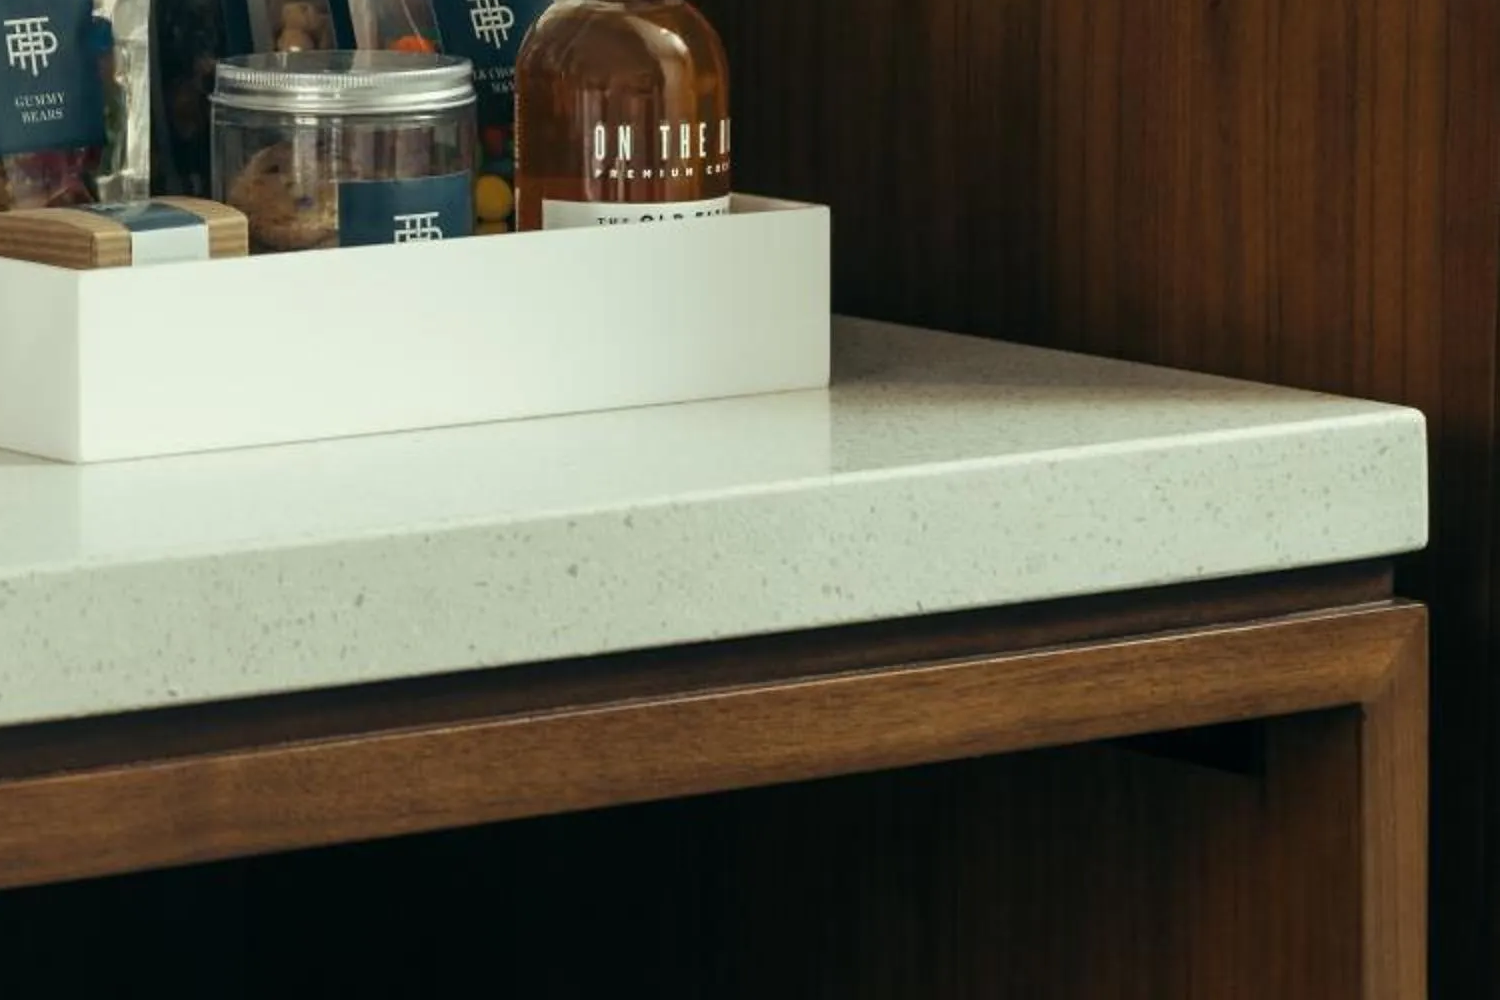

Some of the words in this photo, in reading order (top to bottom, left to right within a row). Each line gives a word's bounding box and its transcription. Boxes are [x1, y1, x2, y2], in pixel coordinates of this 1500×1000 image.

[15, 92, 66, 108] GUMMY
[21, 107, 64, 125] BEARS
[594, 124, 632, 161] ON
[659, 121, 707, 161] THE
[594, 167, 694, 179] PREMIUM
